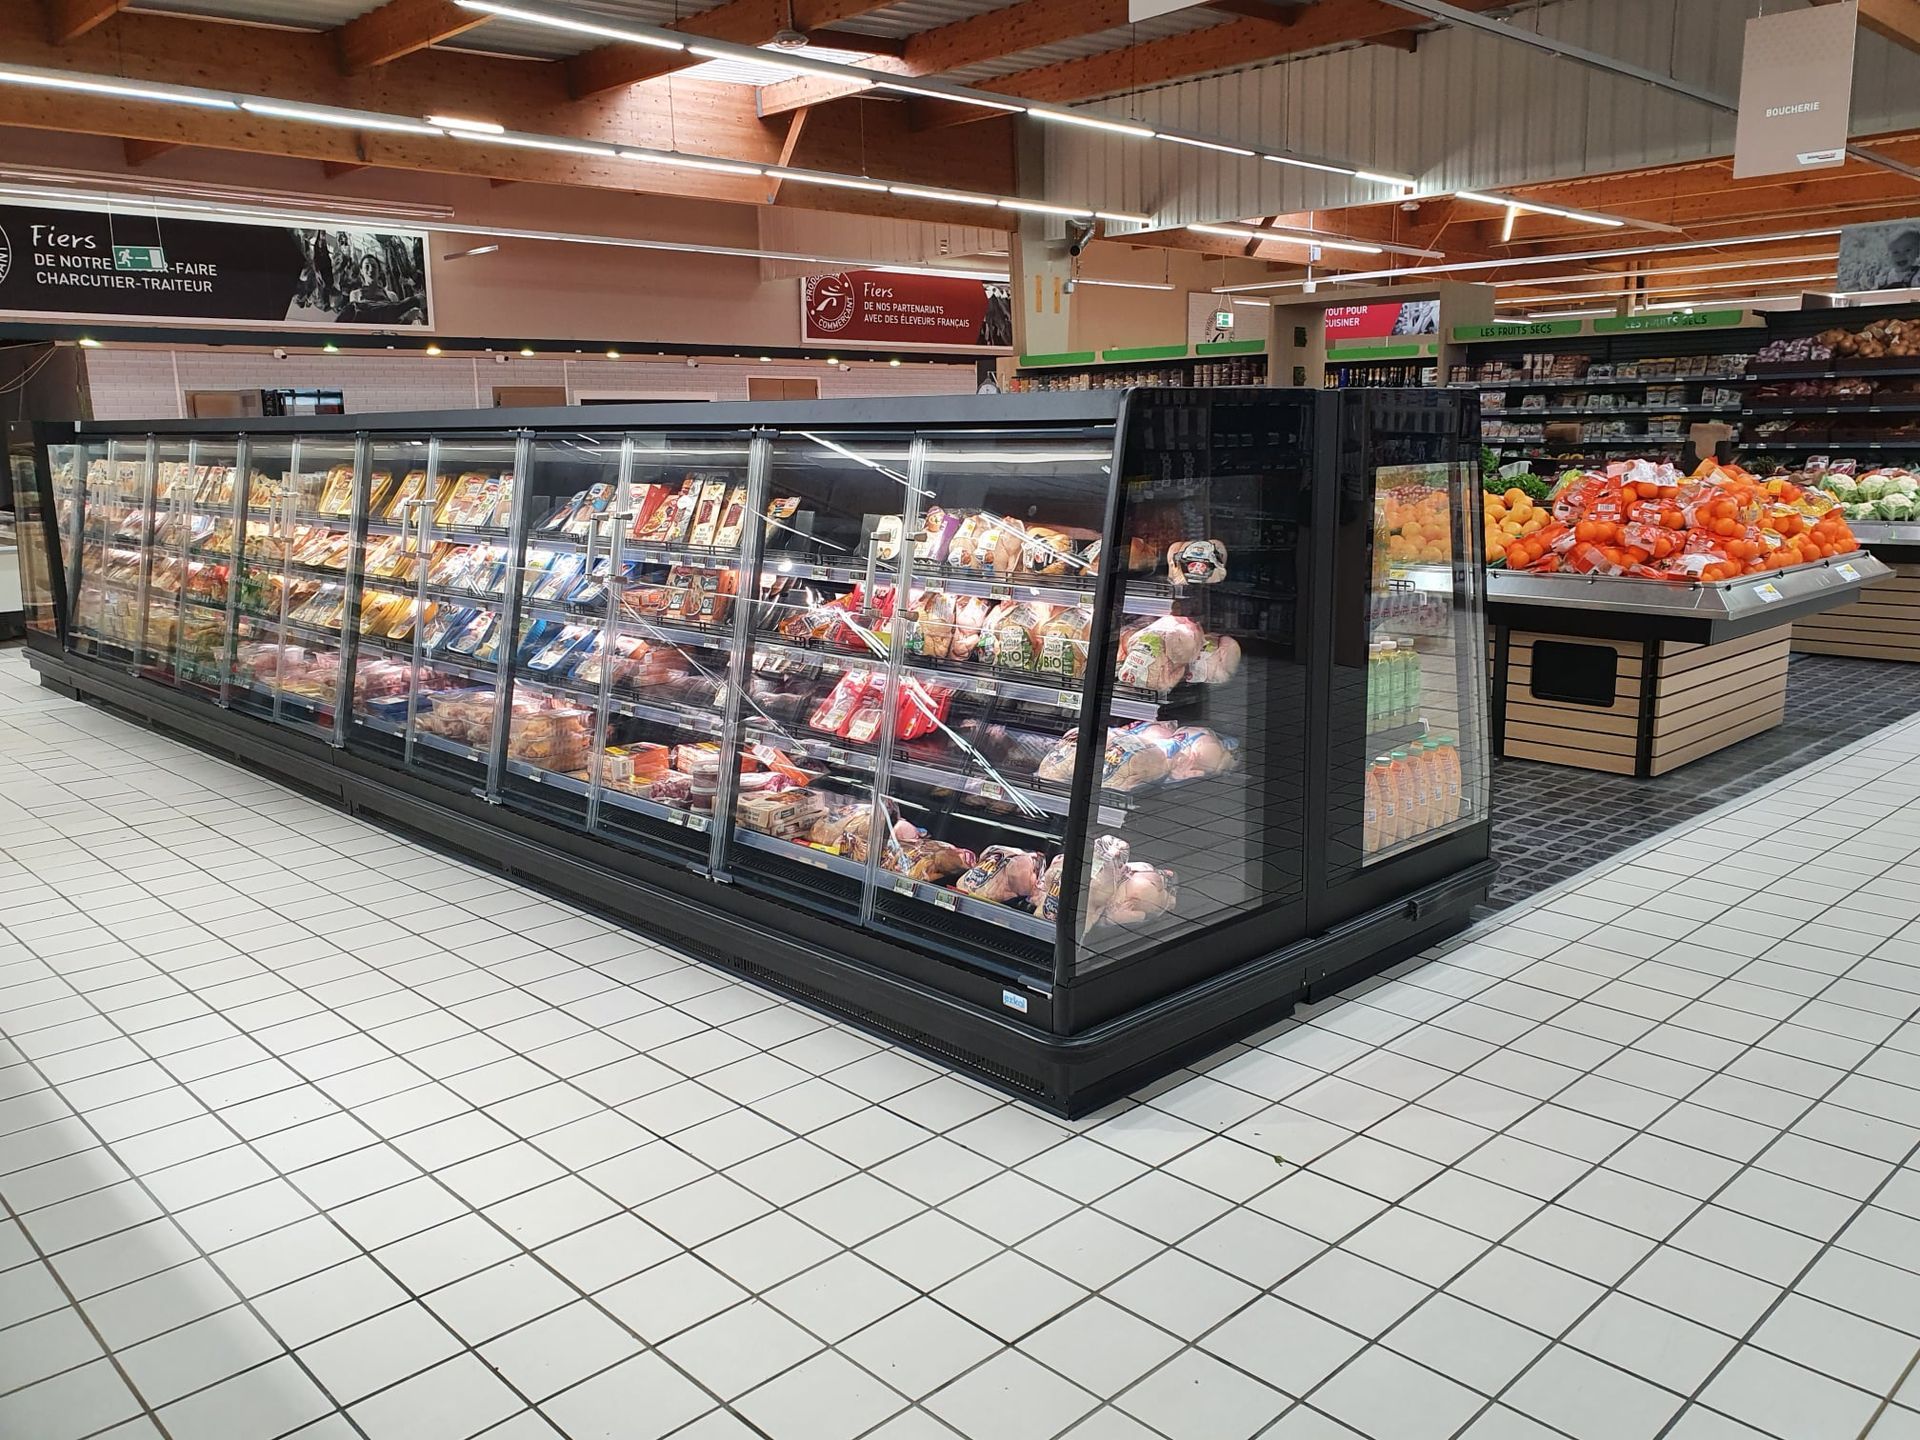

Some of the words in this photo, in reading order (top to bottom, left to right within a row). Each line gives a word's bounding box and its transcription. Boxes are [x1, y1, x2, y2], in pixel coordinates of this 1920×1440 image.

[1766, 101, 1820, 118] BOUCHERIE
[30, 224, 97, 249] Fiers
[34, 253, 56, 267] DE
[59, 255, 112, 270] NOTRE
[36, 271, 213, 293] CHARCUTIER-TRAITEUR
[863, 282, 894, 298] Fiers
[864, 301, 874, 310] DE
[876, 302, 891, 311] NOS
[893, 303, 944, 314] PARTENARIATS
[1346, 305, 1368, 315] POUR
[864, 314, 883, 323] AVEC
[884, 314, 899, 324] DES
[900, 314, 936, 326] ÉLEVEURS
[937, 317, 970, 329] FRANÇAIS
[1325, 317, 1360, 328] CUISINER
[1624, 320, 1641, 329] LES
[1682, 313, 1708, 326] SECS
[1480, 327, 1495, 337] LES
[1498, 325, 1527, 336] FRUITS
[1530, 323, 1552, 335] SECS
